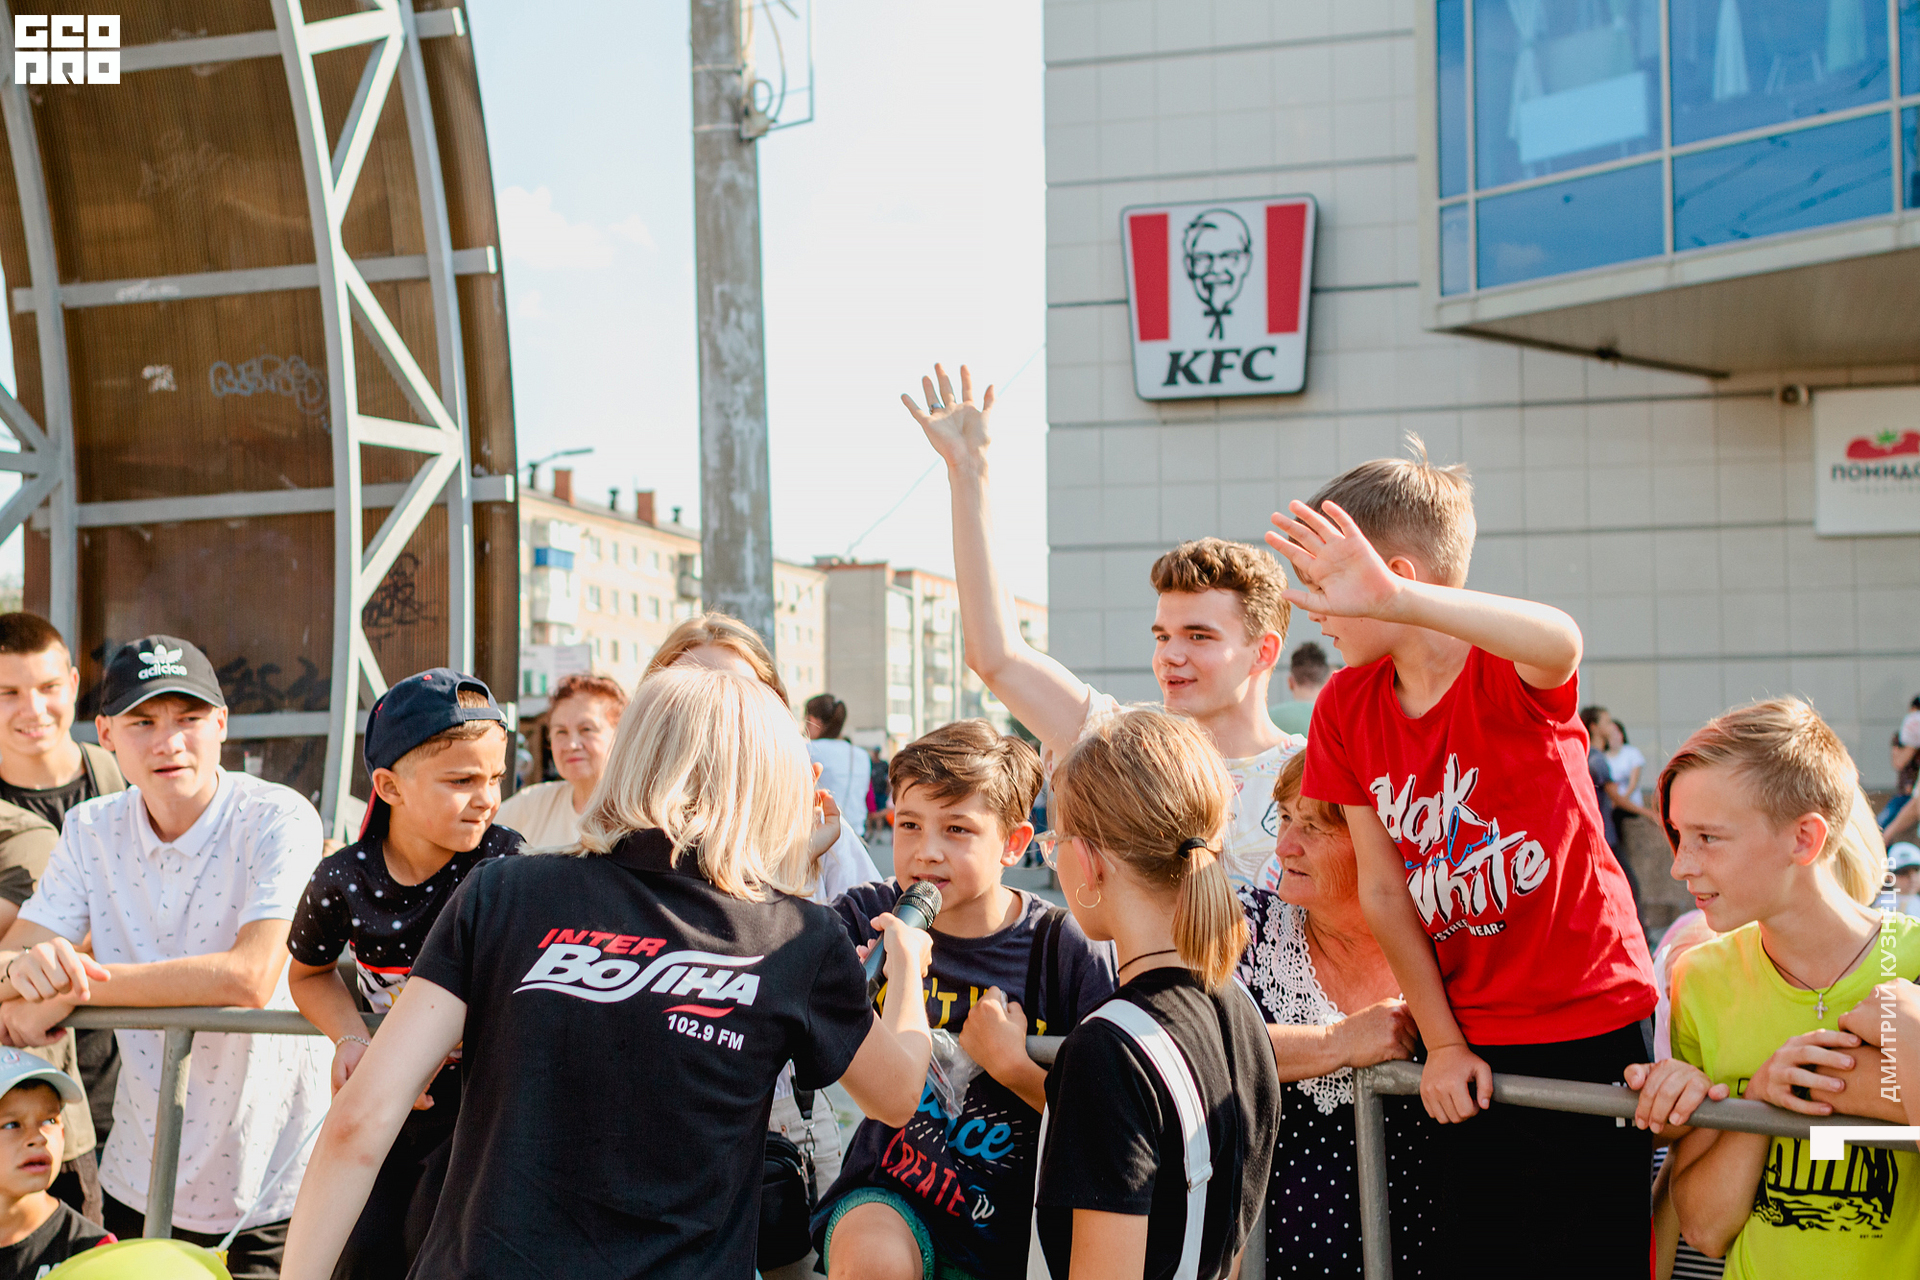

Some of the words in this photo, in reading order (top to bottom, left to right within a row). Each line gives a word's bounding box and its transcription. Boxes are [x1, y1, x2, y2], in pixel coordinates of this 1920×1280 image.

[1162, 346, 1277, 387] KFC
[138, 660, 188, 680] adidas
[538, 928, 667, 957] INTER
[668, 1014, 713, 1042] 102.9
[717, 1028, 745, 1051] FM
[881, 1128, 966, 1217] CREATE
